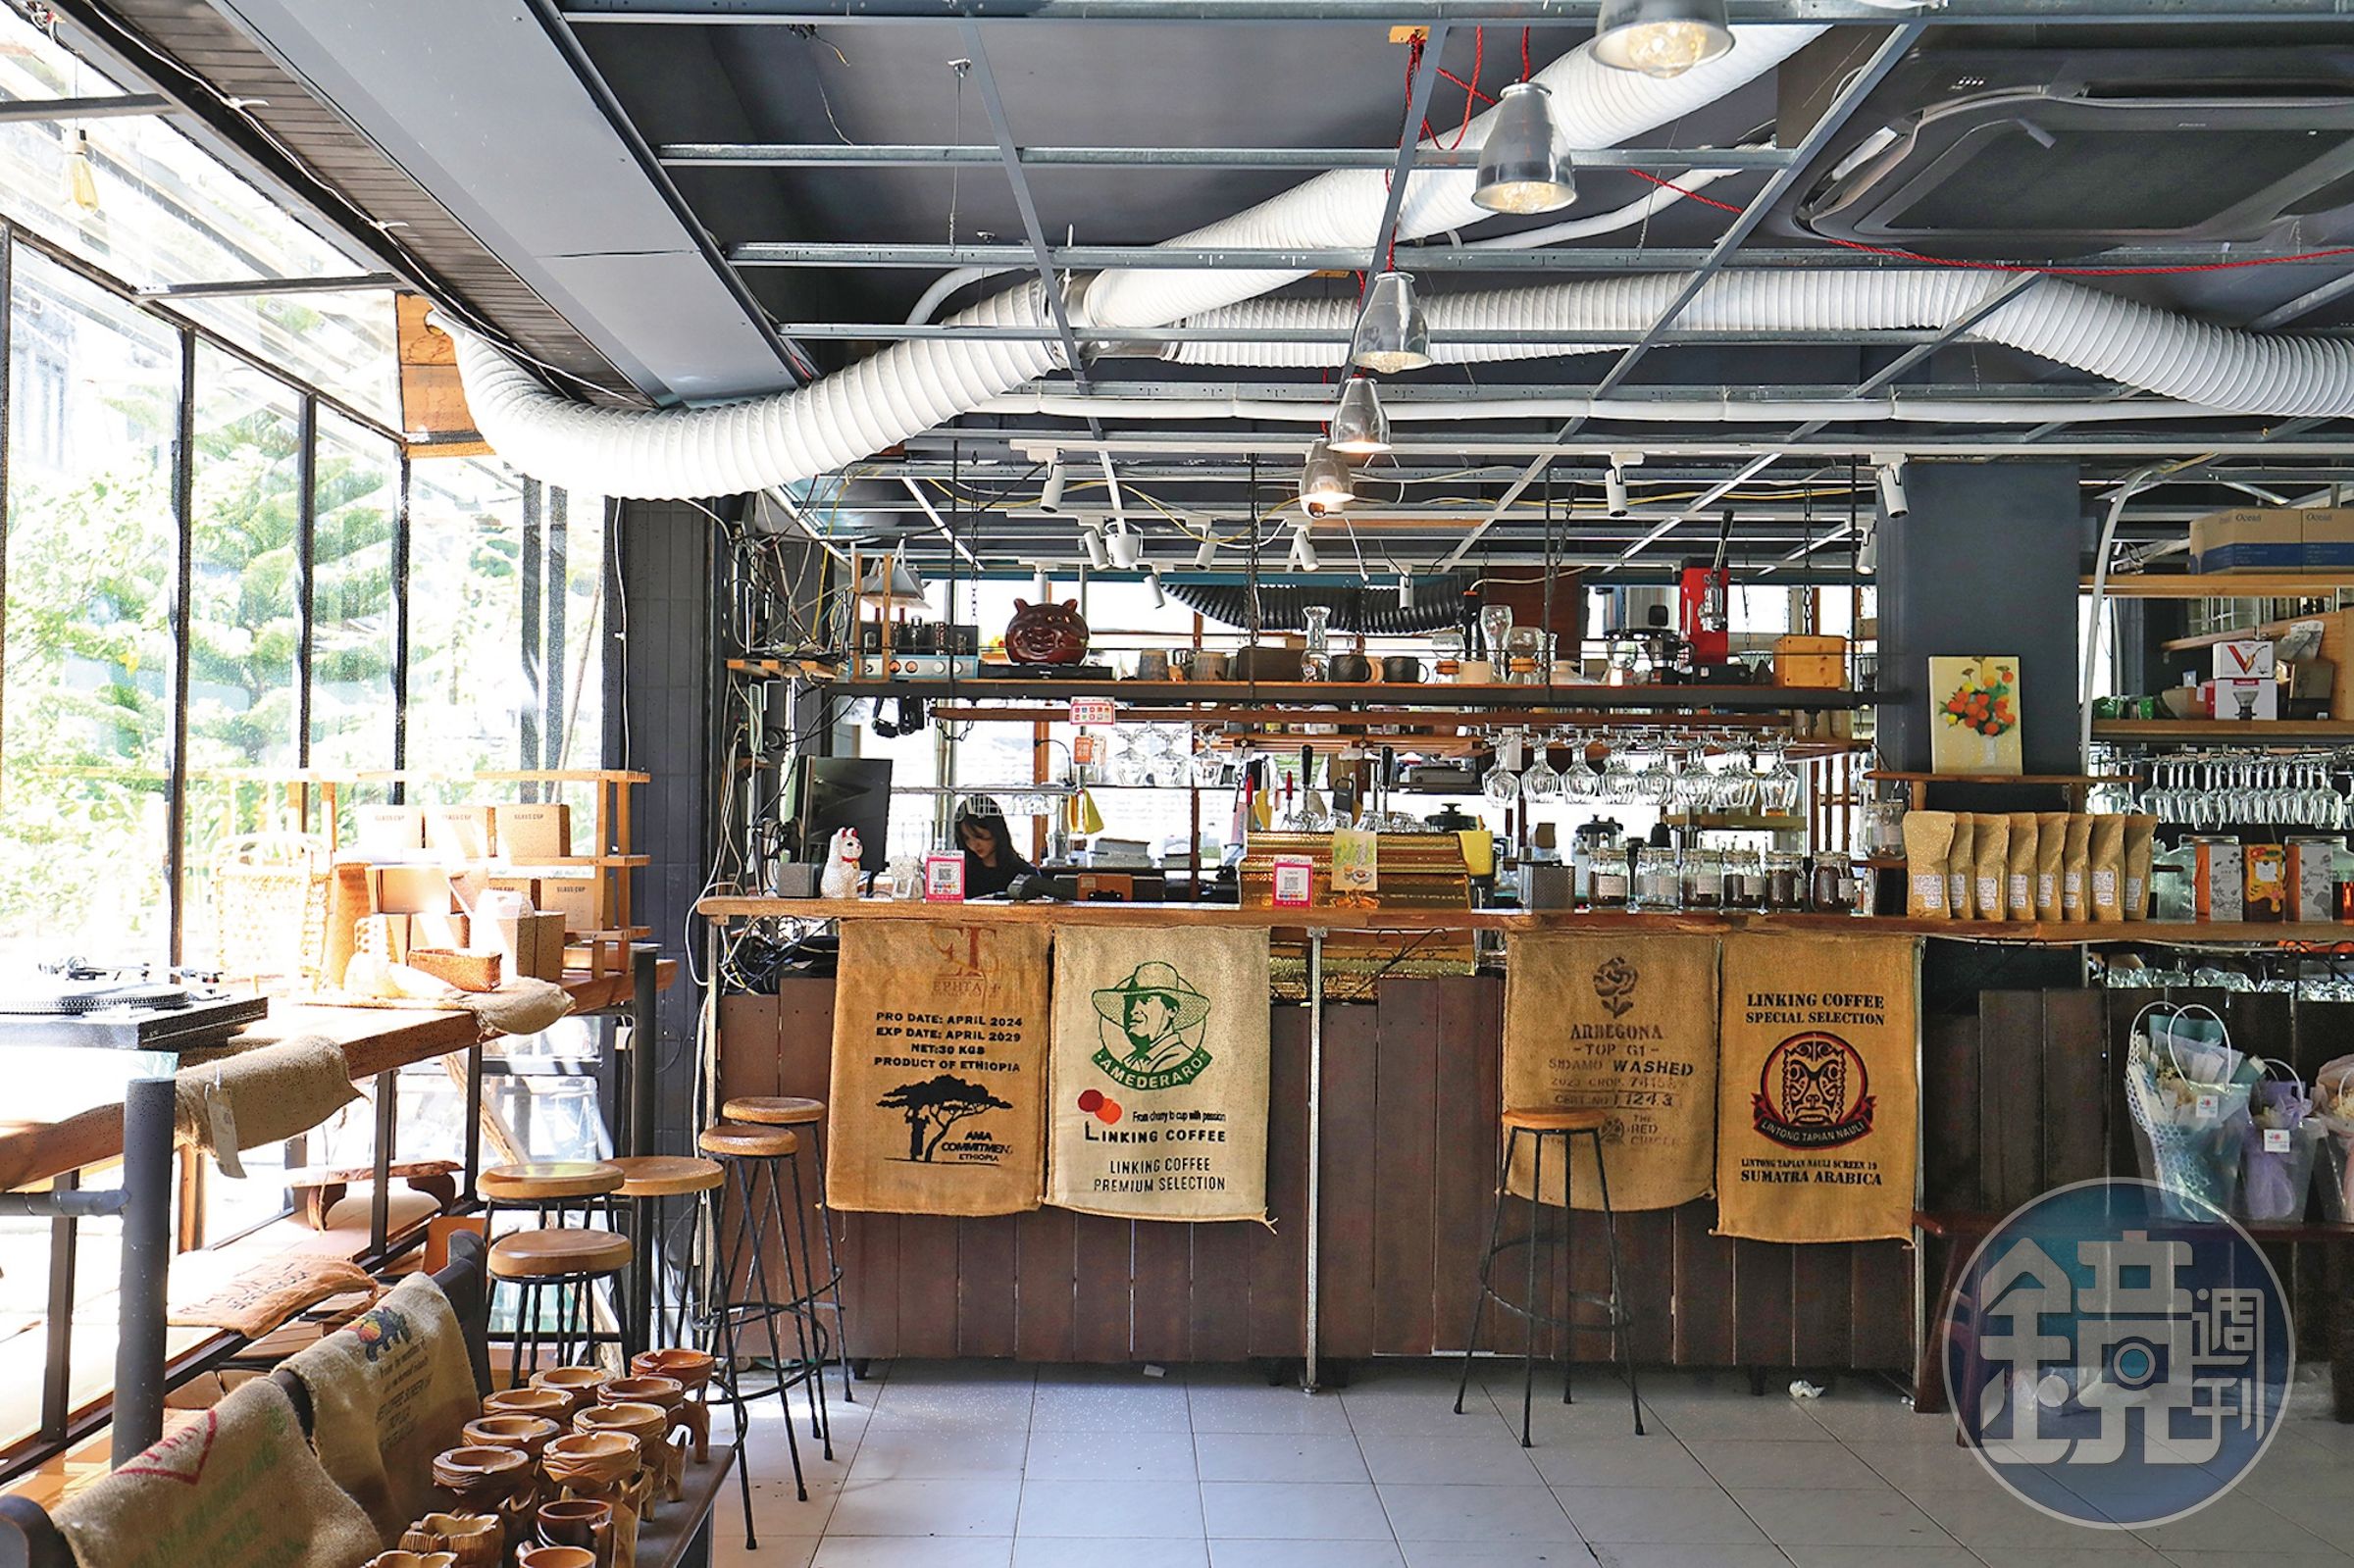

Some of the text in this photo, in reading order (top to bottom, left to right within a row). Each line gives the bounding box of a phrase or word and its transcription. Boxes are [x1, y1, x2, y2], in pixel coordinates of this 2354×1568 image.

[2235, 513, 2262, 522] Ocean
[2306, 512, 2332, 522] Ocean
[1747, 992, 1884, 1009] LINKING COFFEE
[876, 1012, 1023, 1027] PRO DATE: APRIL 2024
[1746, 1012, 1885, 1026] SPECIAL SELECTION
[876, 1027, 1021, 1042] EXP DATE: APRIL 2029
[1570, 1024, 1663, 1040] ARBEGONA
[958, 1045, 986, 1055] KGS
[874, 1057, 1021, 1072] PRODUCT OF ETHIOPIA
[1612, 1059, 1694, 1076] WASHED
[1100, 1057, 1203, 1088] AMEDERARO
[1133, 1110, 1149, 1122] From
[1176, 1112, 1189, 1122] cup
[1189, 1109, 1202, 1120] with
[1203, 1111, 1226, 1123] passion
[1084, 1121, 1226, 1143] LINKING COFFEE
[1631, 1124, 1658, 1134] RED
[1761, 1120, 1865, 1142] LINTONG TAPIAN NAULI
[958, 1153, 999, 1162] ETHIOPIA
[1741, 1158, 1775, 1167] LINTONG
[1777, 1159, 1806, 1168] TAPIAN
[1807, 1159, 1831, 1168] NAULI
[1833, 1159, 1866, 1170] SCREEN
[1109, 1157, 1210, 1175] LINKING COFFEE
[1094, 1177, 1225, 1192] PREMIUM SELECTION
[1741, 1170, 1882, 1186] SUMATRA ARABICA
